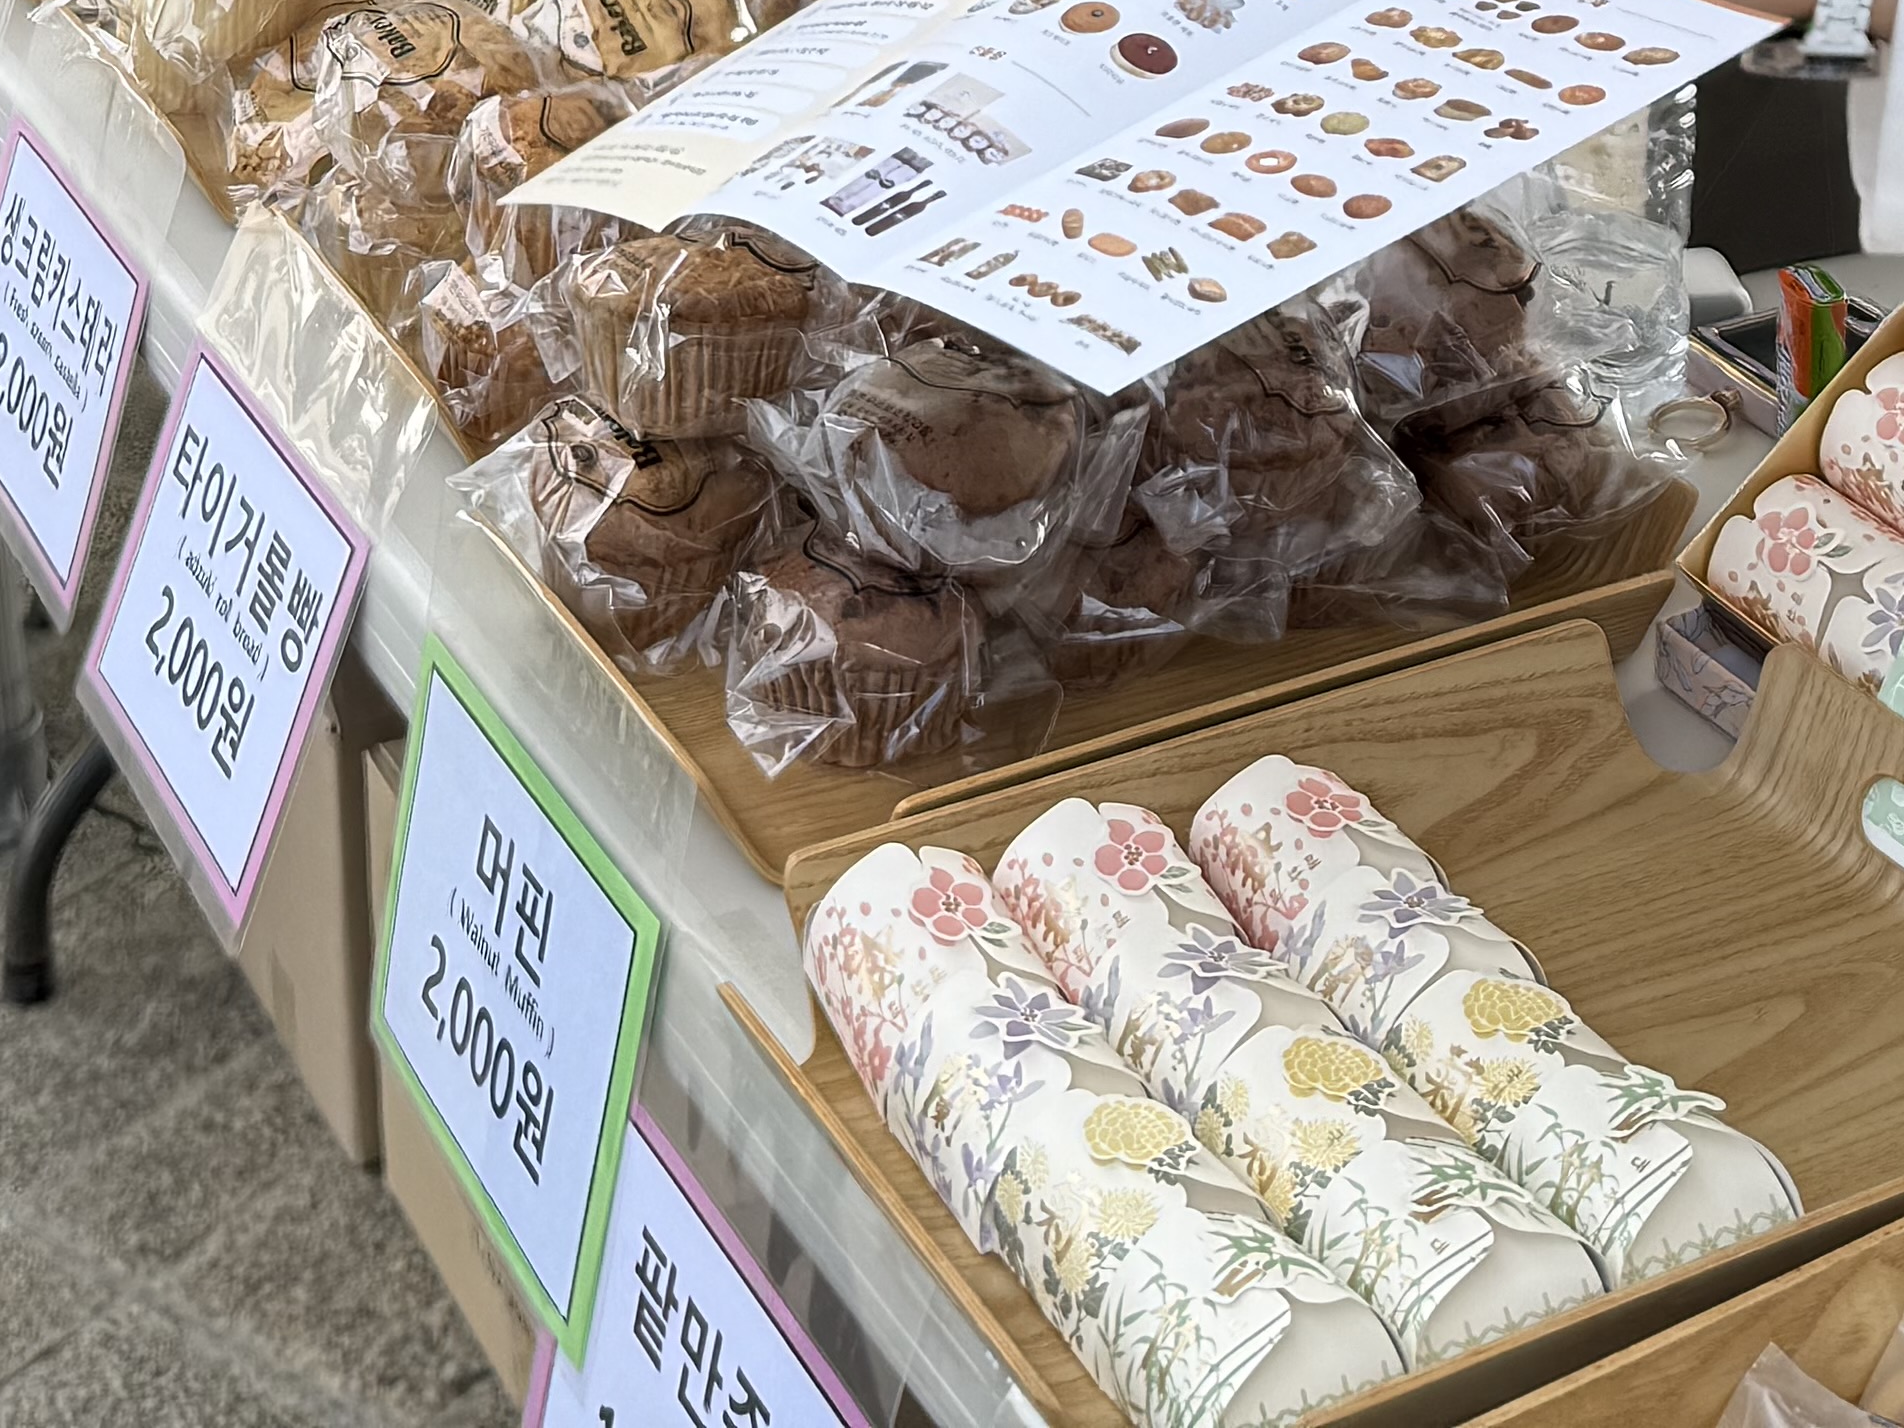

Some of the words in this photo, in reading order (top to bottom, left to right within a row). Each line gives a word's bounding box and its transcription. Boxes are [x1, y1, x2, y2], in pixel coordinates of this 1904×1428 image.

[0, 191, 118, 399] 생크림카스테라
[172, 422, 324, 673] 타이거롤빵
[145, 585, 256, 781] 2,000원
[459, 896, 501, 978] Walnut
[503, 962, 544, 1043] Muffin
[475, 812, 555, 989] 머핀
[420, 933, 555, 1187] 2,000원
